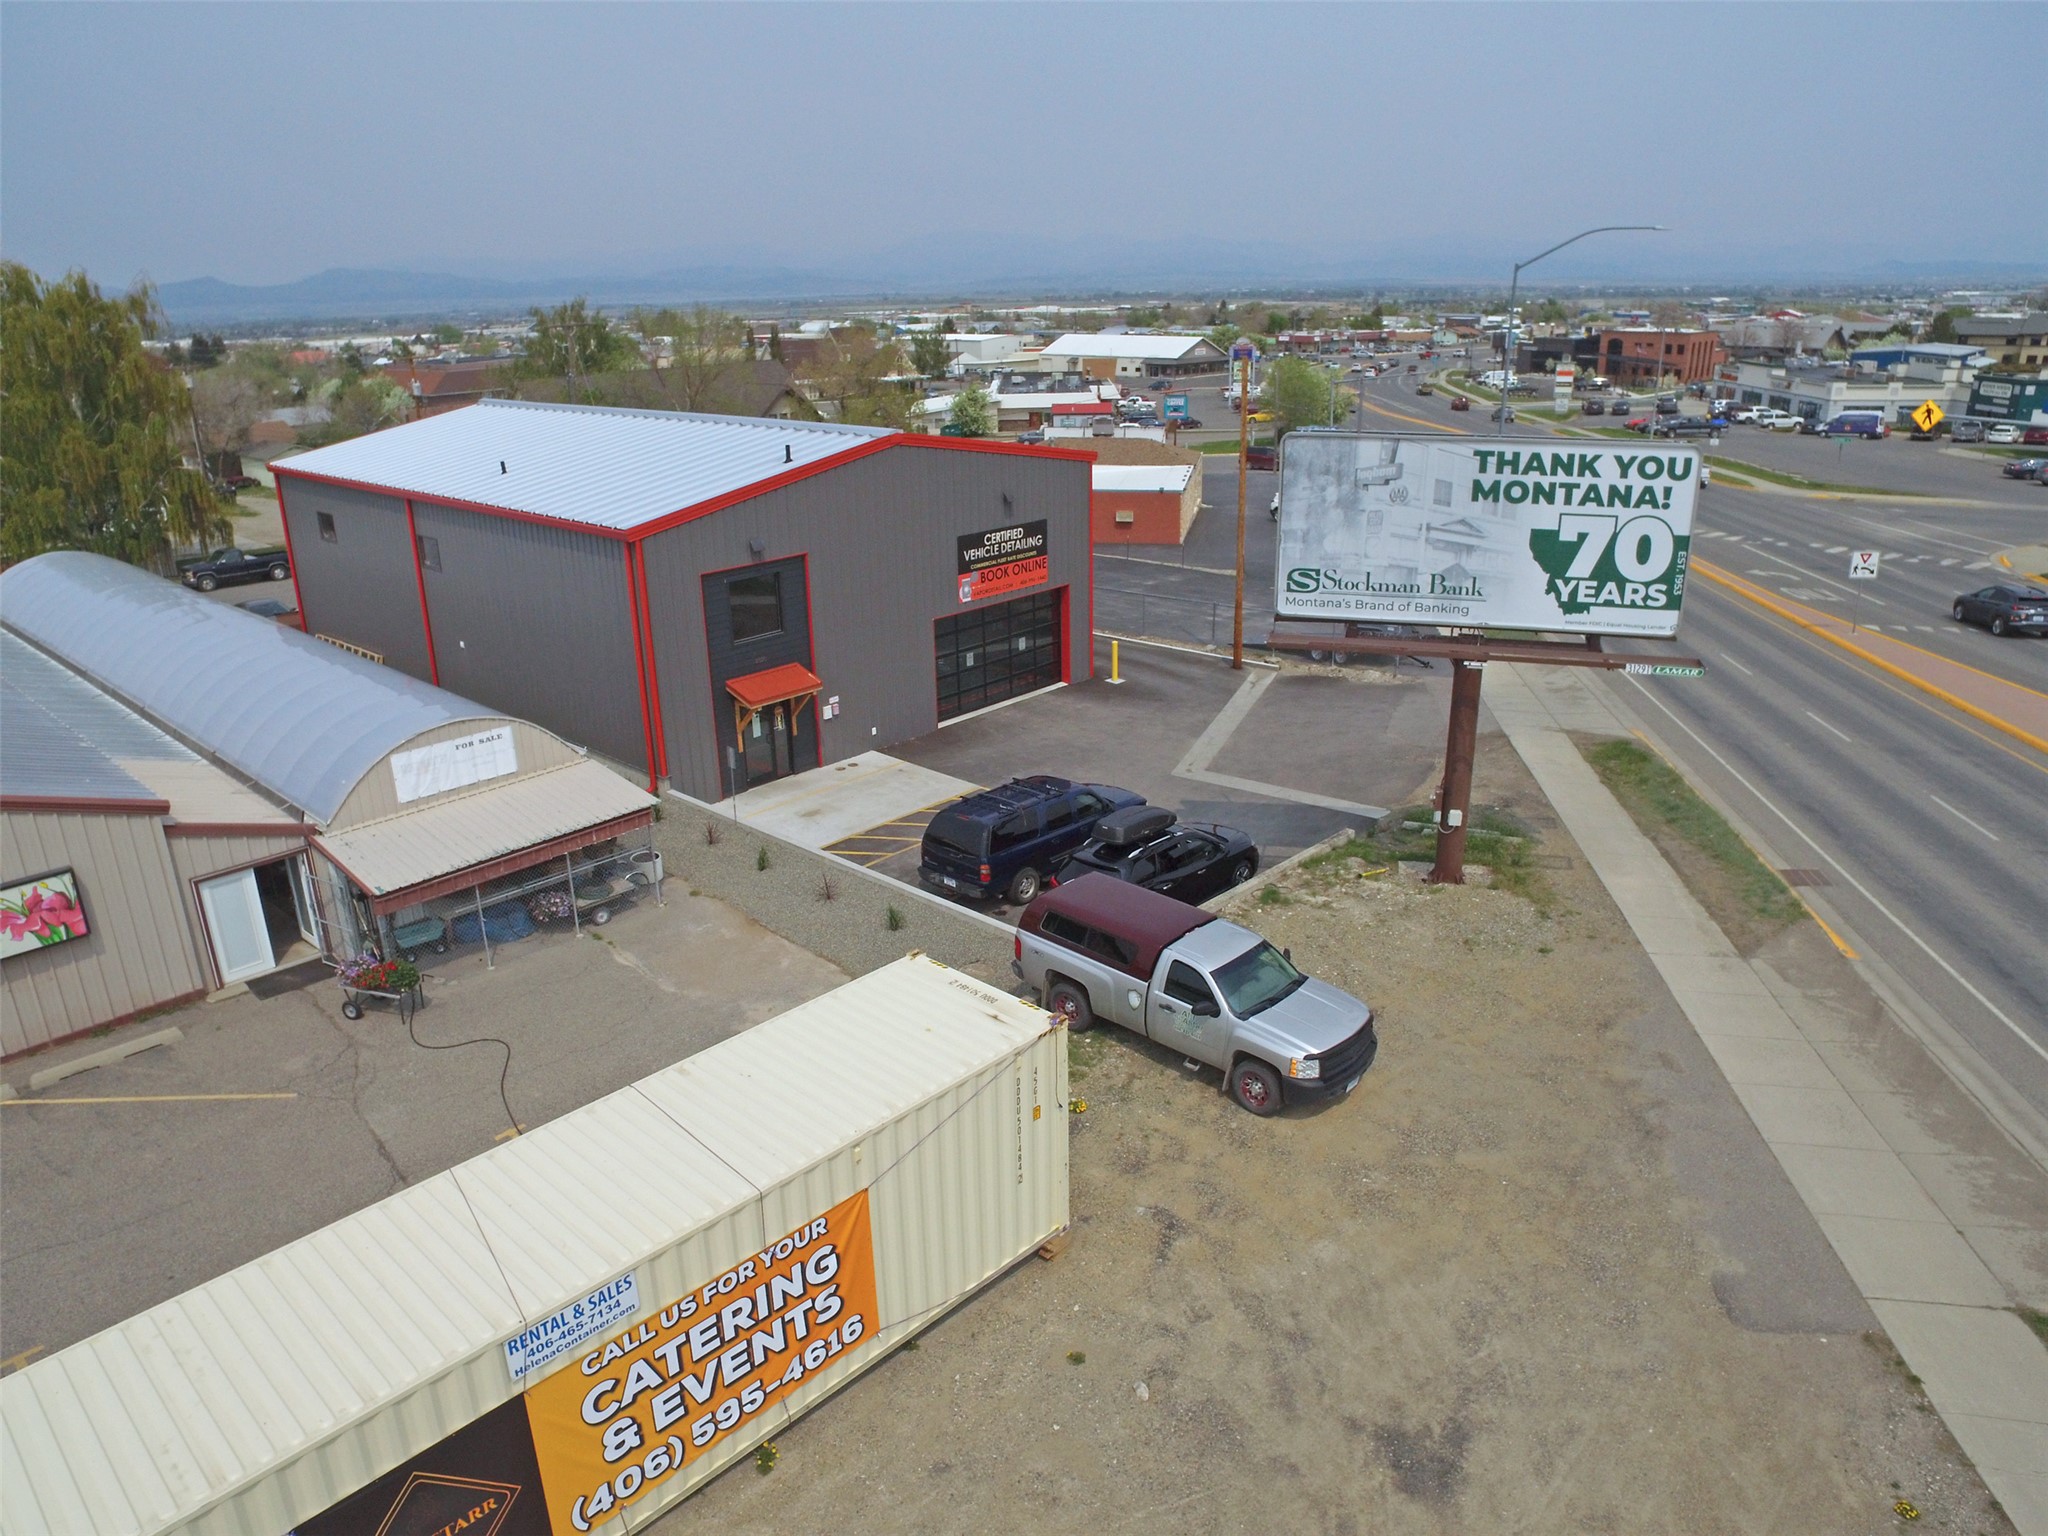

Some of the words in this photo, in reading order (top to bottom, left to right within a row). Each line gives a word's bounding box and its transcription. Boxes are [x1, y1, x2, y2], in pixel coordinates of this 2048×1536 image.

[1472, 449, 1602, 478] THANK
[1614, 454, 1692, 482] YOU
[1471, 479, 1673, 510] MONTANA!
[964, 545, 1000, 562] VEHICLE
[1000, 536, 1042, 554] DETAILING
[984, 528, 1024, 546] CERTIFIED
[1558, 513, 1674, 583] 70
[980, 566, 1010, 584] BOOK
[1012, 558, 1048, 576] ONLINE
[1676, 551, 1686, 572] EST.
[1322, 568, 1420, 594] Stockman
[1430, 573, 1484, 597] Bank
[1555, 579, 1668, 608] YEARS
[1673, 574, 1684, 596] 1953
[1285, 596, 1351, 609] Montana's
[1355, 599, 1394, 611] Brand
[1398, 600, 1412, 612] of
[1415, 602, 1470, 616] Banking
[1656, 667, 1698, 676] LAMAR
[454, 741, 474, 750] FOR
[478, 734, 503, 744] SALE
[582, 1328, 657, 1375] CALL
[660, 1294, 698, 1328] US
[702, 1261, 758, 1306] FOR
[759, 1216, 828, 1270] YOUR
[507, 1310, 570, 1356] RENTAL
[572, 1303, 585, 1319] &
[588, 1274, 632, 1312] SALES
[526, 1299, 622, 1358] 406-465-7134
[514, 1304, 636, 1377] HelenaContainer.com
[581, 1244, 839, 1426] CATERING
[602, 1416, 642, 1464] &
[650, 1284, 844, 1433] EVENTS
[572, 1436, 685, 1531] (406)
[692, 1314, 864, 1446] 595-4616
